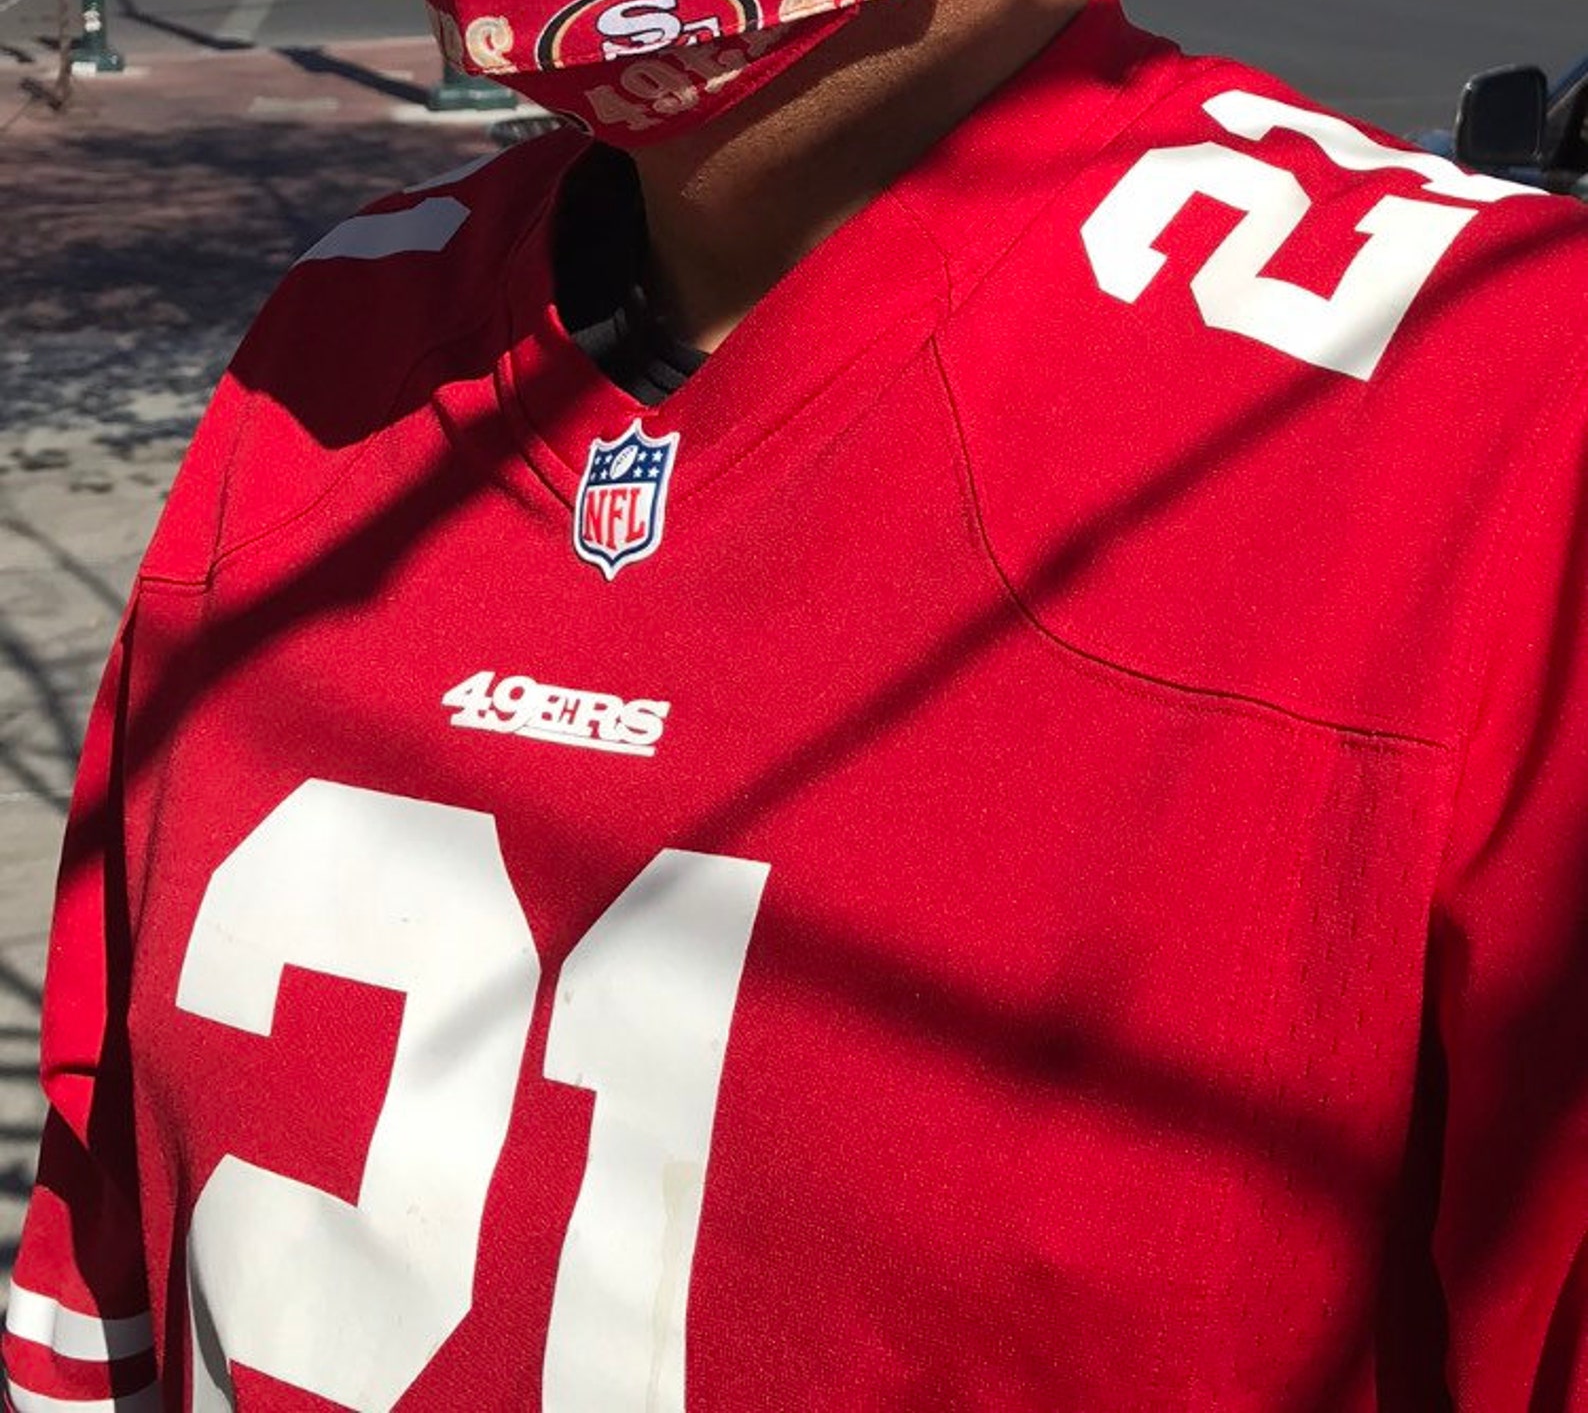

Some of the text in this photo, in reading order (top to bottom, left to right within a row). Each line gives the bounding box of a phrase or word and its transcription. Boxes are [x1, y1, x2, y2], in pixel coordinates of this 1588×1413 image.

[583, 487, 645, 551] NFL
[441, 670, 671, 757] 49ERS
[175, 777, 771, 1413] 21
